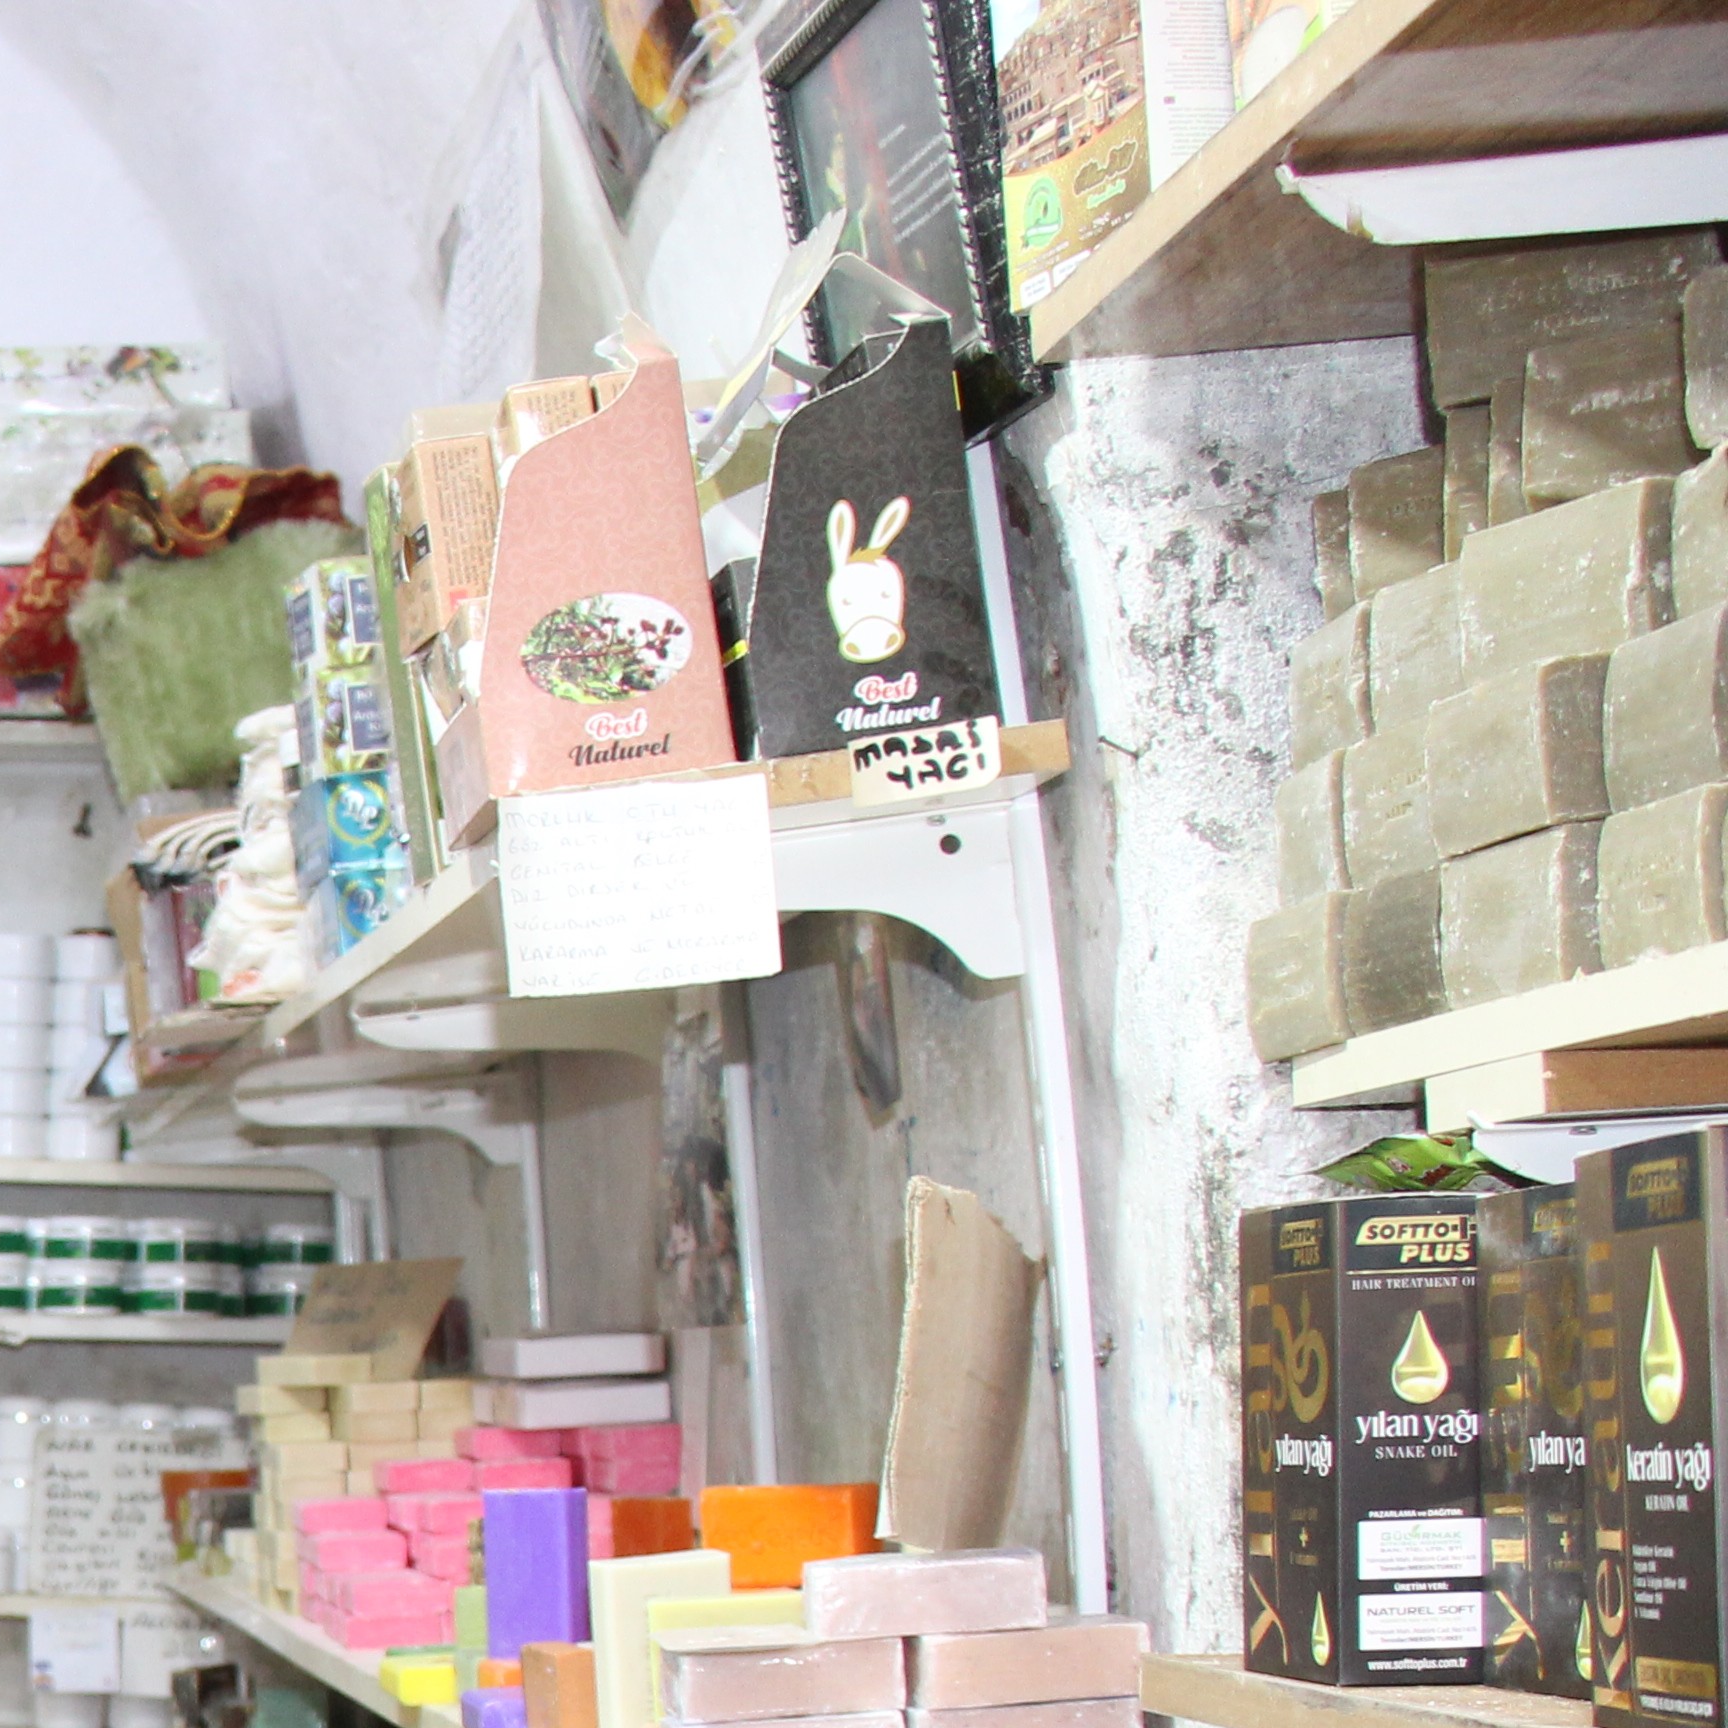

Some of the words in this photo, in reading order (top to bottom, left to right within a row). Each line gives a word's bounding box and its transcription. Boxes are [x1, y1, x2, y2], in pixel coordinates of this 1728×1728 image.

[856, 673, 920, 702] Best
[586, 709, 648, 740] Best
[837, 697, 941, 733] Naturel
[569, 733, 671, 768] Naturel
[1400, 1242, 1471, 1264] PLUS
[1351, 1278, 1382, 1290] HAIR
[1387, 1277, 1458, 1289] TREATMENT
[1355, 1410, 1419, 1444] yılan
[1423, 1408, 1478, 1444] yağı
[1274, 1433, 1303, 1473] yılan
[1303, 1434, 1333, 1477] yağı
[1374, 1445, 1425, 1460] SNAKE
[1431, 1444, 1458, 1458] OIL
[1529, 1430, 1565, 1473] yılan
[1626, 1440, 1673, 1483] keratin
[1674, 1443, 1711, 1492] yağı
[1366, 1606, 1435, 1617] NATUREL
[1438, 1604, 1476, 1615] SOFT
[1367, 1656, 1468, 1672] www.softtoplus.com.tr
